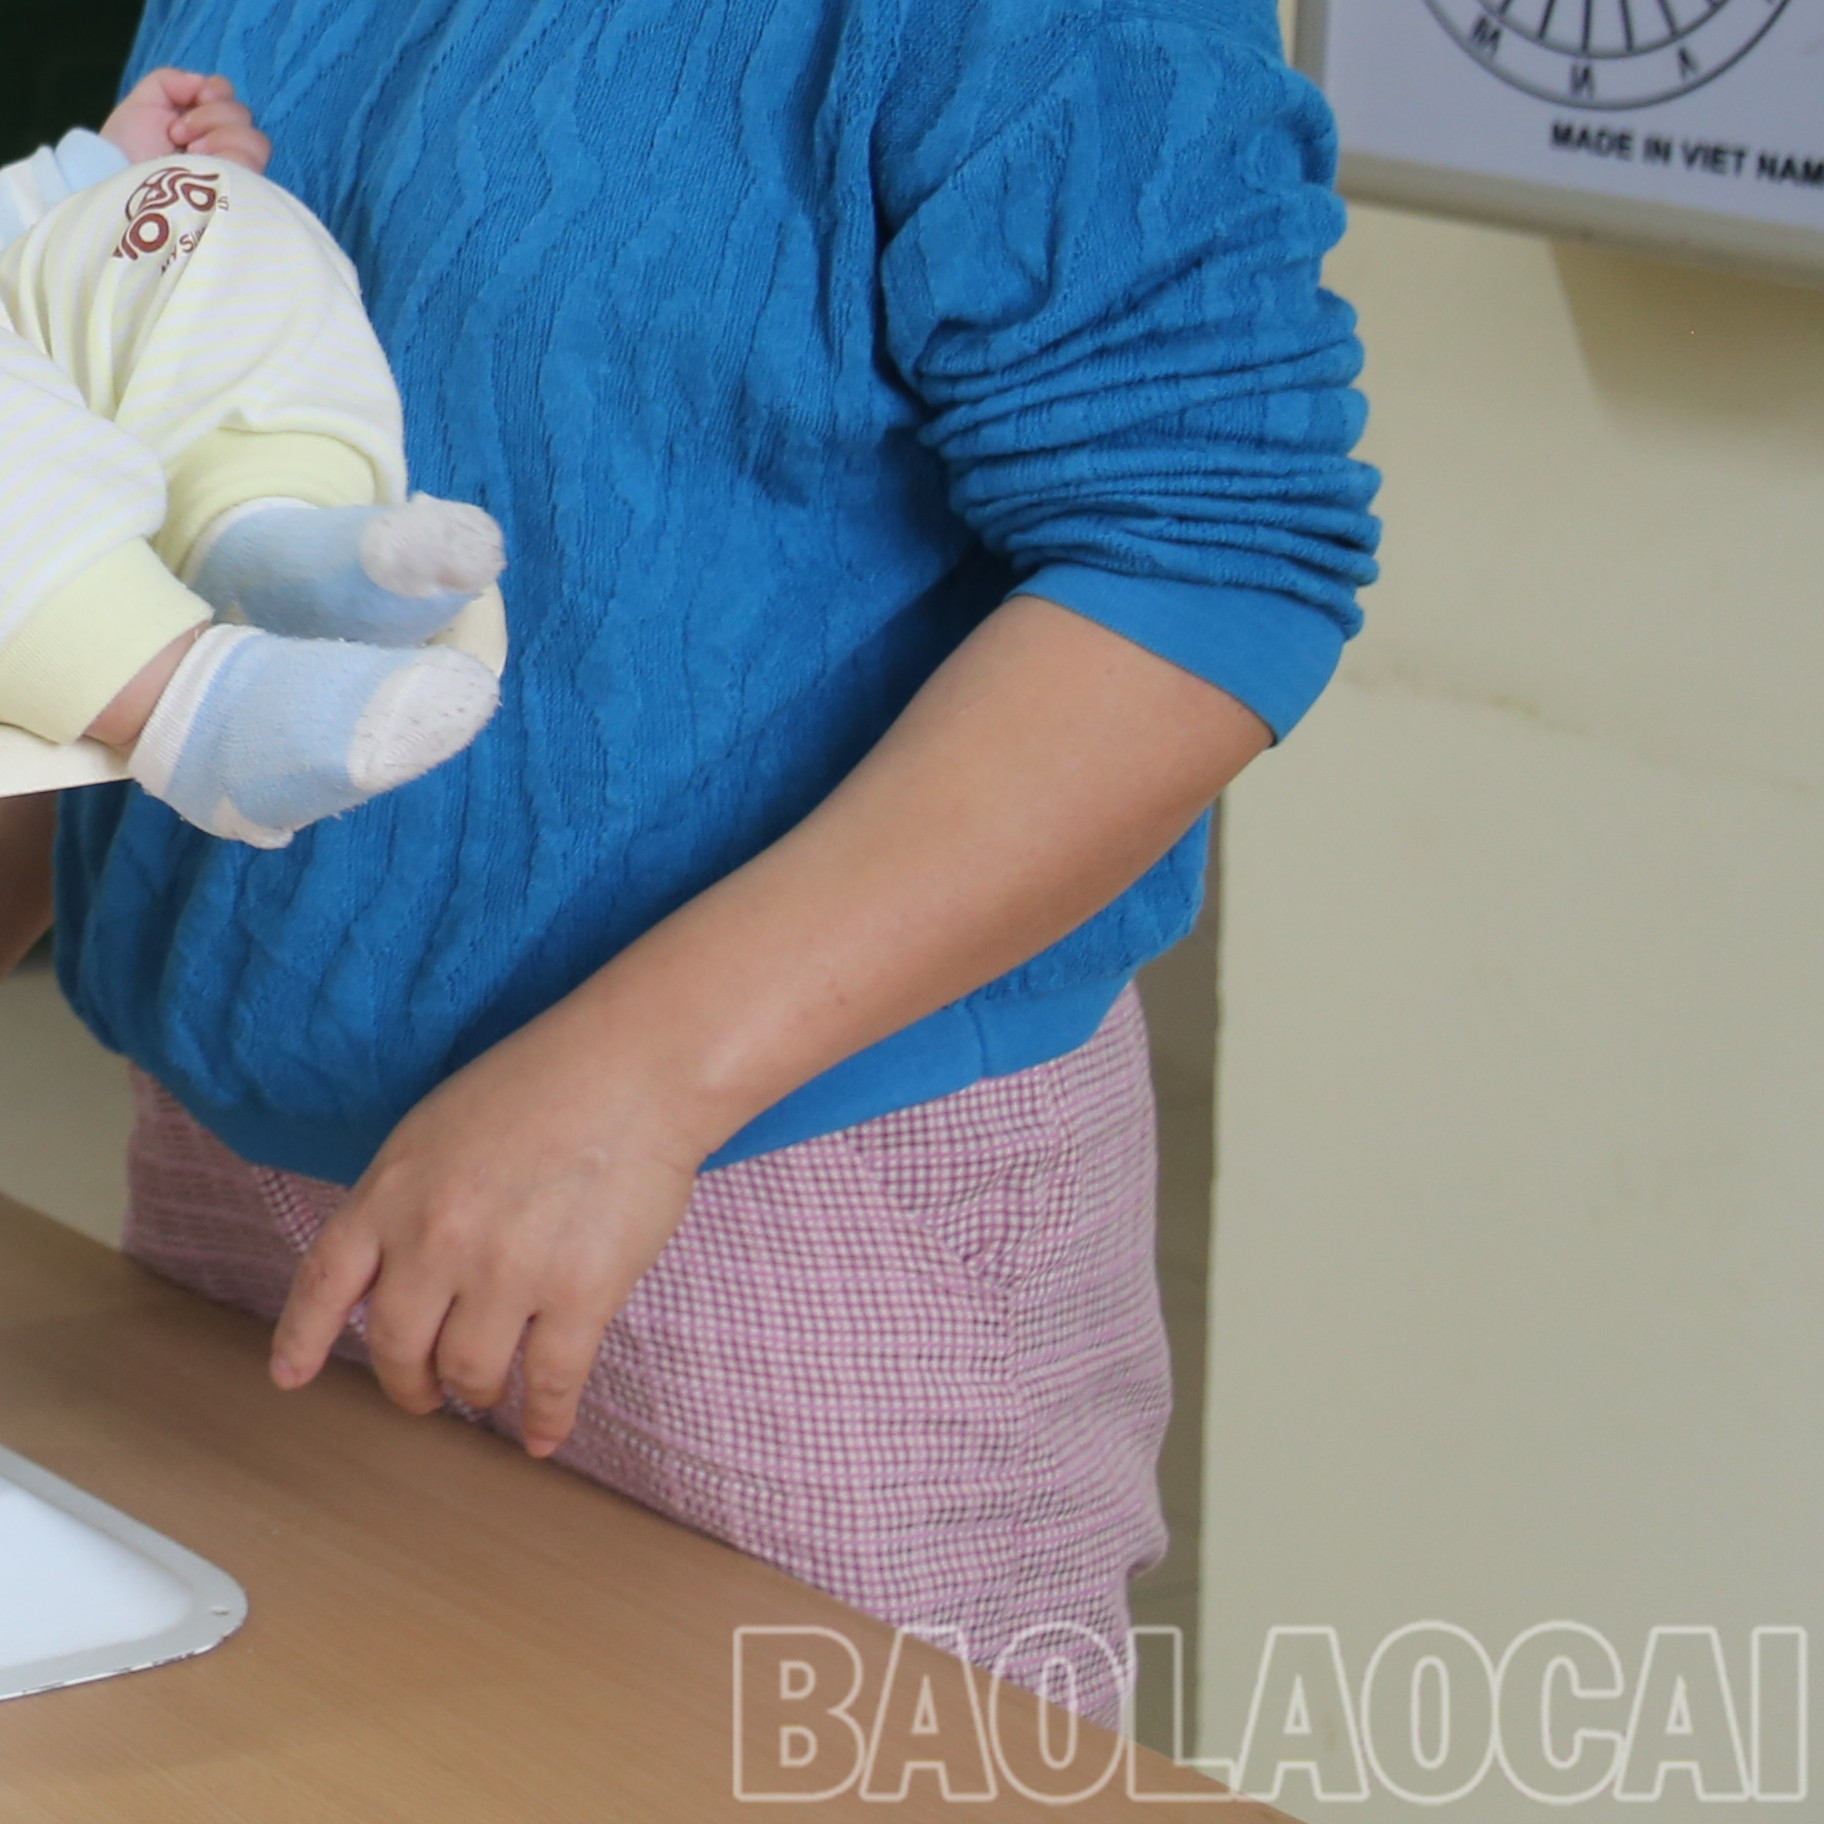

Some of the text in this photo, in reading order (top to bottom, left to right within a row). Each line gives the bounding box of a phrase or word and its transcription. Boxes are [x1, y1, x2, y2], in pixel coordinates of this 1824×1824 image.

[1550, 120, 1824, 190] MADE IN VIET NAM
